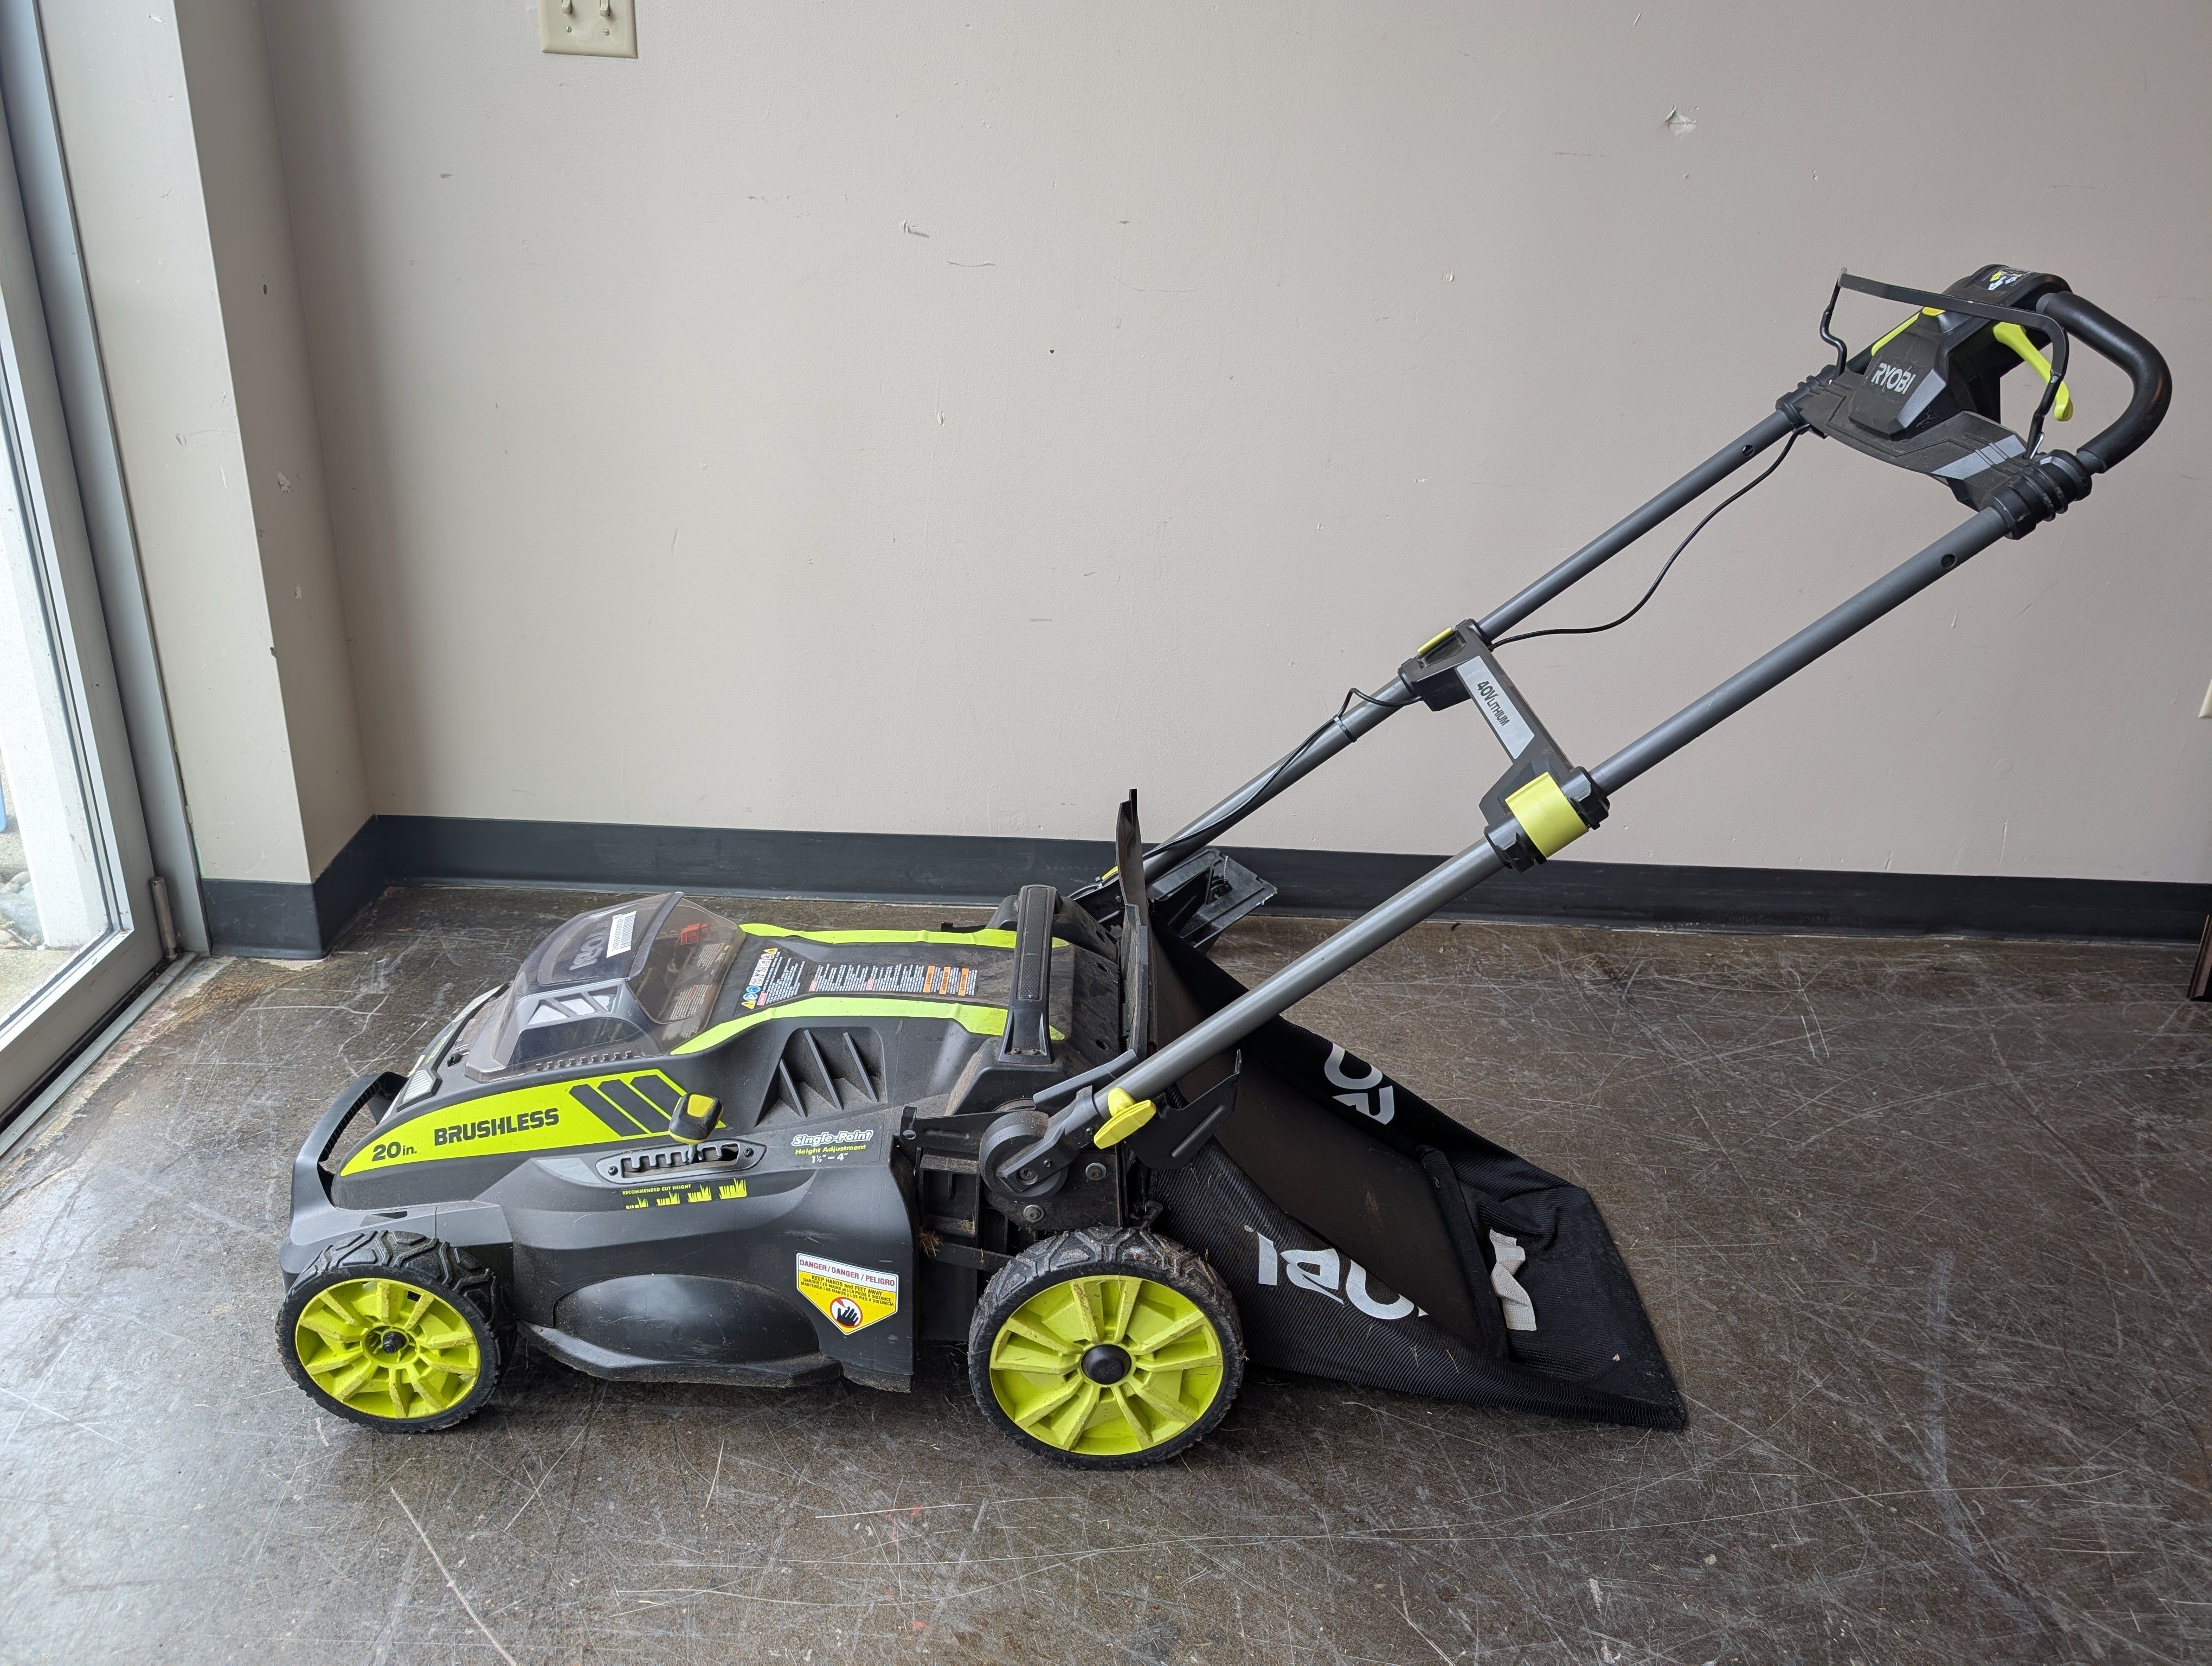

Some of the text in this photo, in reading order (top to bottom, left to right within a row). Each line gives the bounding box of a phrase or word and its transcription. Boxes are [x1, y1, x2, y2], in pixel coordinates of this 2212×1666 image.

[1870, 362, 1917, 394] RYOBI
[1487, 697, 1510, 727] LITHIUM
[434, 1107, 560, 1146] BRUSHLESS
[792, 1130, 874, 1146] Single-Point
[822, 1144, 866, 1153] Adjustment
[622, 1187, 660, 1195] RECOMMENDED
[800, 1259, 827, 1271] DANGER
[831, 1266, 859, 1279] DANGER
[865, 1274, 895, 1286] PELIGRO
[825, 1278, 843, 1287] HANDS
